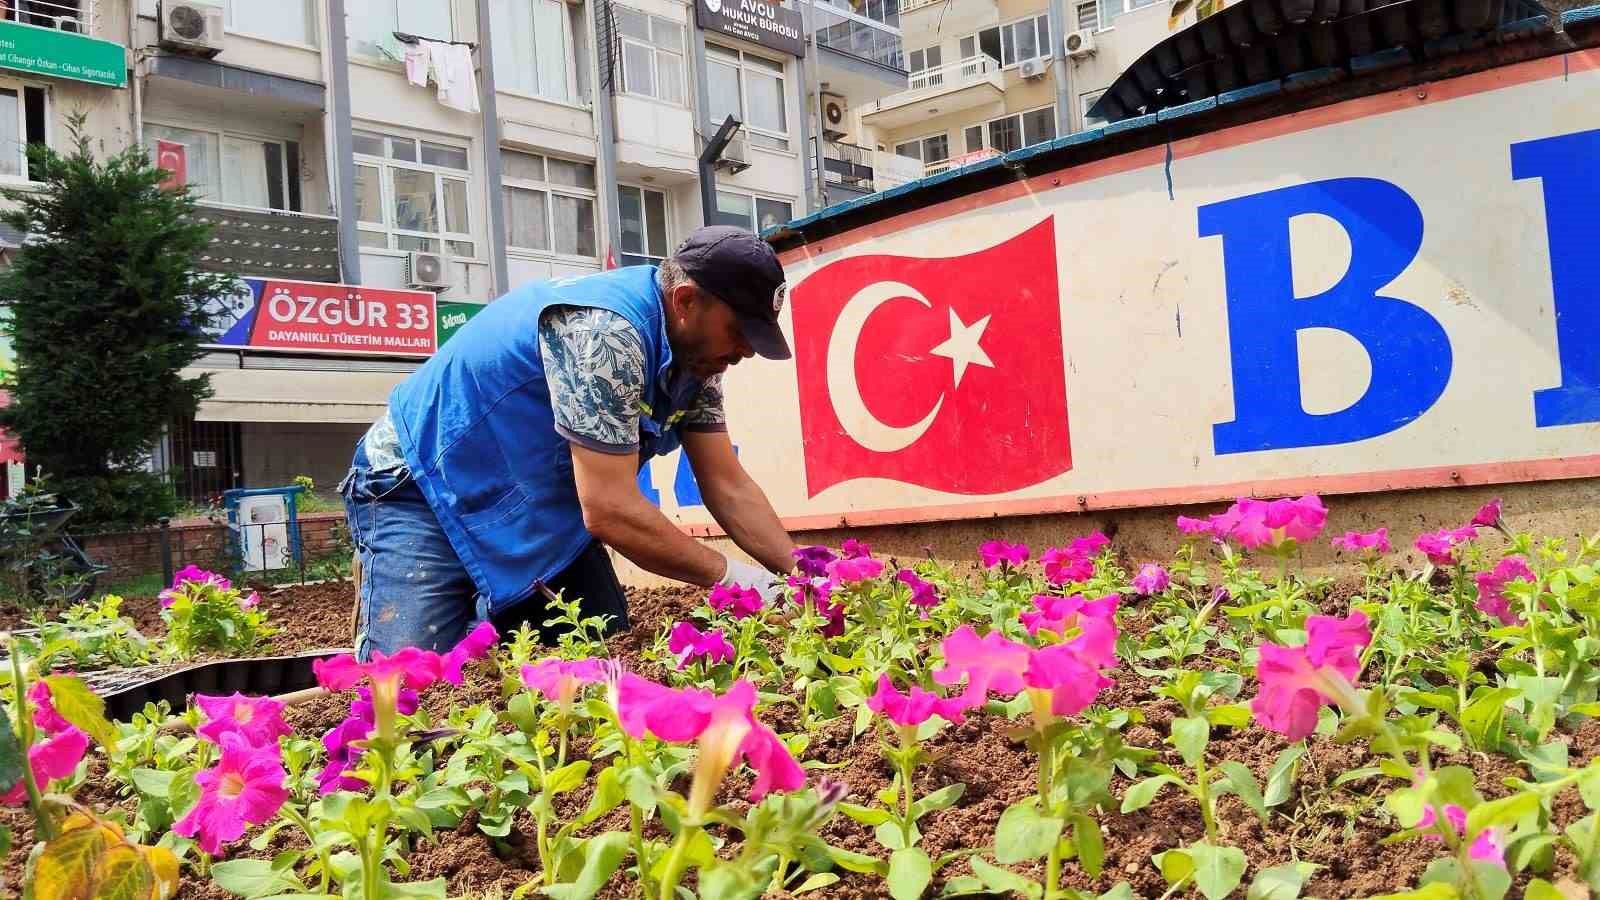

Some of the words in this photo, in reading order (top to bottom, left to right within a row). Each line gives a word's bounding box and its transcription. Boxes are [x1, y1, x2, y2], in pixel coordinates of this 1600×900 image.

[722, 6, 758, 26] HUKUK
[741, 0, 775, 19] AVCU
[268, 288, 388, 328] ÖZGÜR
[396, 303, 430, 330] 33
[268, 331, 330, 343] DAYANIKLI
[332, 332, 382, 346] TÜKETİM
[384, 336, 431, 348] MALLARI
